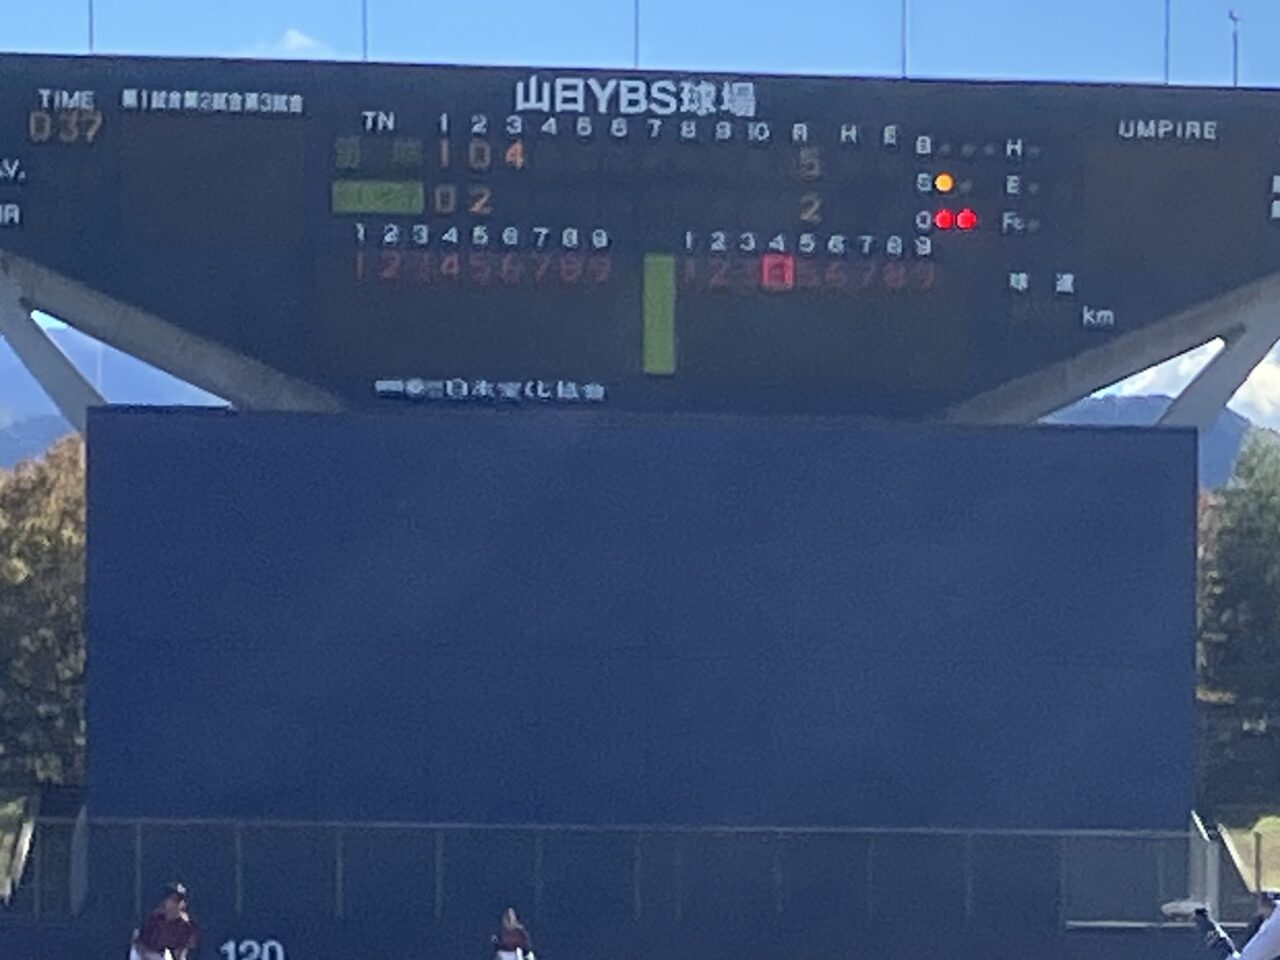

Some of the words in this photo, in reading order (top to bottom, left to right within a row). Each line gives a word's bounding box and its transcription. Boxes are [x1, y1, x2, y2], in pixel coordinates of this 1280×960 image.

[39, 89, 93, 110] TIME
[515, 75, 755, 117] 山日YBS球場
[362, 111, 394, 130] TN
[1119, 120, 1216, 139] UMPIRE
[504, 140, 527, 169] 4
[1007, 139, 1022, 155] H
[1007, 176, 1019, 193] E
[468, 185, 493, 215] 2
[1083, 306, 1114, 324] km
